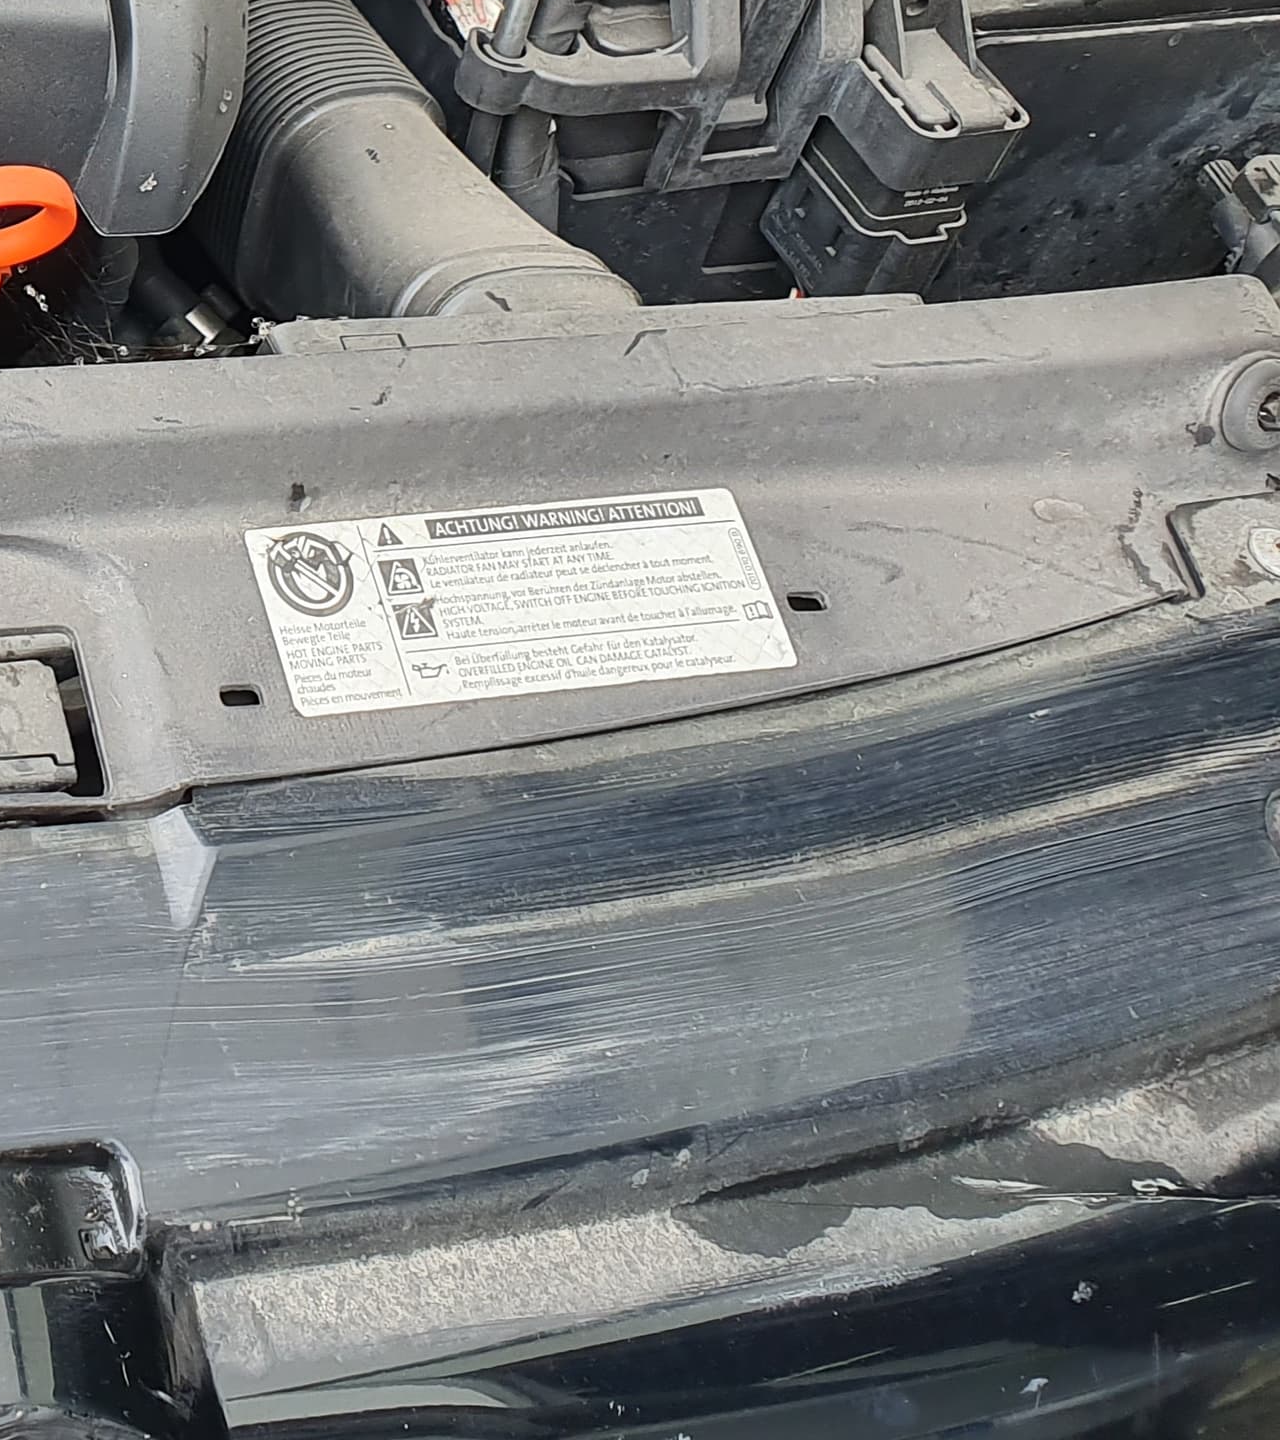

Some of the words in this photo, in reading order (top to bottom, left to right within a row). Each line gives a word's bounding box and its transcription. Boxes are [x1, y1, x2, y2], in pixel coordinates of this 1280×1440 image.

[436, 515, 519, 536] ACHTUNG!
[520, 508, 605, 528] WARNING!
[609, 500, 697, 521] ATTENTION!
[500, 549, 525, 558] kann
[526, 544, 568, 559] jederzeit
[426, 564, 474, 577] RADIATOR
[476, 562, 497, 572] FAN
[497, 560, 519, 570] MAY
[521, 556, 550, 569] START
[552, 555, 563, 565] AT
[566, 554, 585, 563] ANY
[429, 580, 442, 589] Le
[442, 575, 494, 587] ventilateur
[496, 572, 509, 583] de
[510, 570, 553, 581] radiateur
[555, 567, 578, 579] peut
[578, 566, 590, 575] se
[649, 558, 671, 569] tout
[510, 589, 526, 598] vor
[572, 582, 588, 592] der
[645, 575, 675, 585] Motor
[438, 605, 466, 617] HIGH
[513, 597, 553, 610] SWITCH
[553, 594, 572, 606] OFF
[573, 591, 611, 604] ENGINE
[611, 587, 648, 600] BEFORE
[647, 583, 701, 597] TOUCHING
[700, 580, 746, 592] IGNITION
[279, 625, 312, 635] Heisse
[313, 619, 366, 631] Motorteile
[446, 629, 477, 640] Haute
[551, 620, 561, 630] le
[562, 618, 597, 628] moteur
[599, 614, 626, 625] avant
[627, 612, 640, 623] de
[639, 610, 676, 621] toucher
[282, 634, 326, 646] Bewegte
[327, 630, 351, 641] Teile
[286, 648, 308, 659] HOT
[311, 644, 349, 657] ENGINE
[351, 641, 383, 652] PARTS
[289, 656, 334, 670] MOVING
[336, 653, 367, 665] PARTS
[454, 655, 471, 666] Bei
[531, 646, 569, 658] besteht
[570, 642, 603, 654] Gefahr
[606, 640, 621, 651] für
[623, 638, 642, 649] den
[323, 670, 337, 681] du
[338, 669, 372, 679] moteur
[458, 663, 516, 678] OVERFILLED
[516, 658, 555, 672] ENGINE
[556, 657, 573, 668] OIL
[576, 655, 598, 666] CAN
[599, 650, 642, 664] DAMAGE
[524, 669, 562, 683] excessif
[598, 664, 650, 677] dangereux
[650, 661, 673, 673] pour
[674, 658, 684, 668] le
[297, 683, 336, 695] chaudes
[330, 695, 344, 704] en
[345, 688, 403, 702] mouvement
